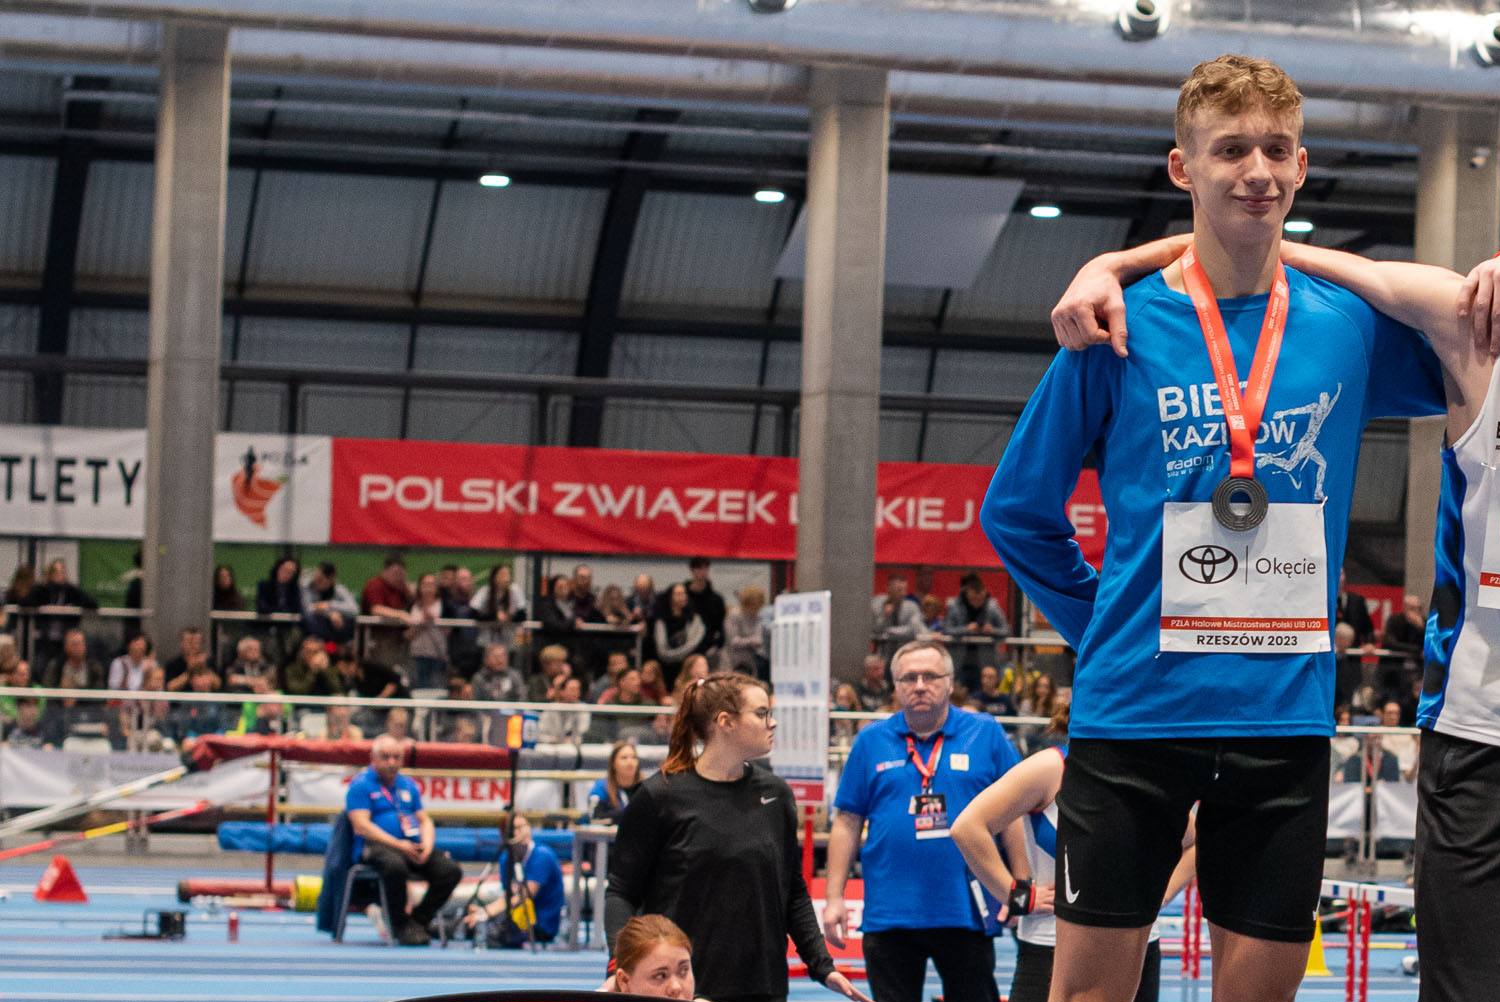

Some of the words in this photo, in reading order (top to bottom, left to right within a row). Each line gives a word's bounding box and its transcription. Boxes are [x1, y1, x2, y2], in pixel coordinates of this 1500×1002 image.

[1157, 380, 1248, 422] BIE
[1162, 421, 1296, 453] KAZIW
[0, 457, 141, 504] TLETY
[359, 474, 537, 515] POLSKI
[552, 482, 777, 528] ZWIĄZEK
[1255, 557, 1316, 578] Okęcie
[1191, 620, 1222, 628] Halowe
[1223, 620, 1271, 629] Mistrzostwa
[1196, 633, 1265, 646] RZESZÓW
[1267, 635, 1298, 646] 2023
